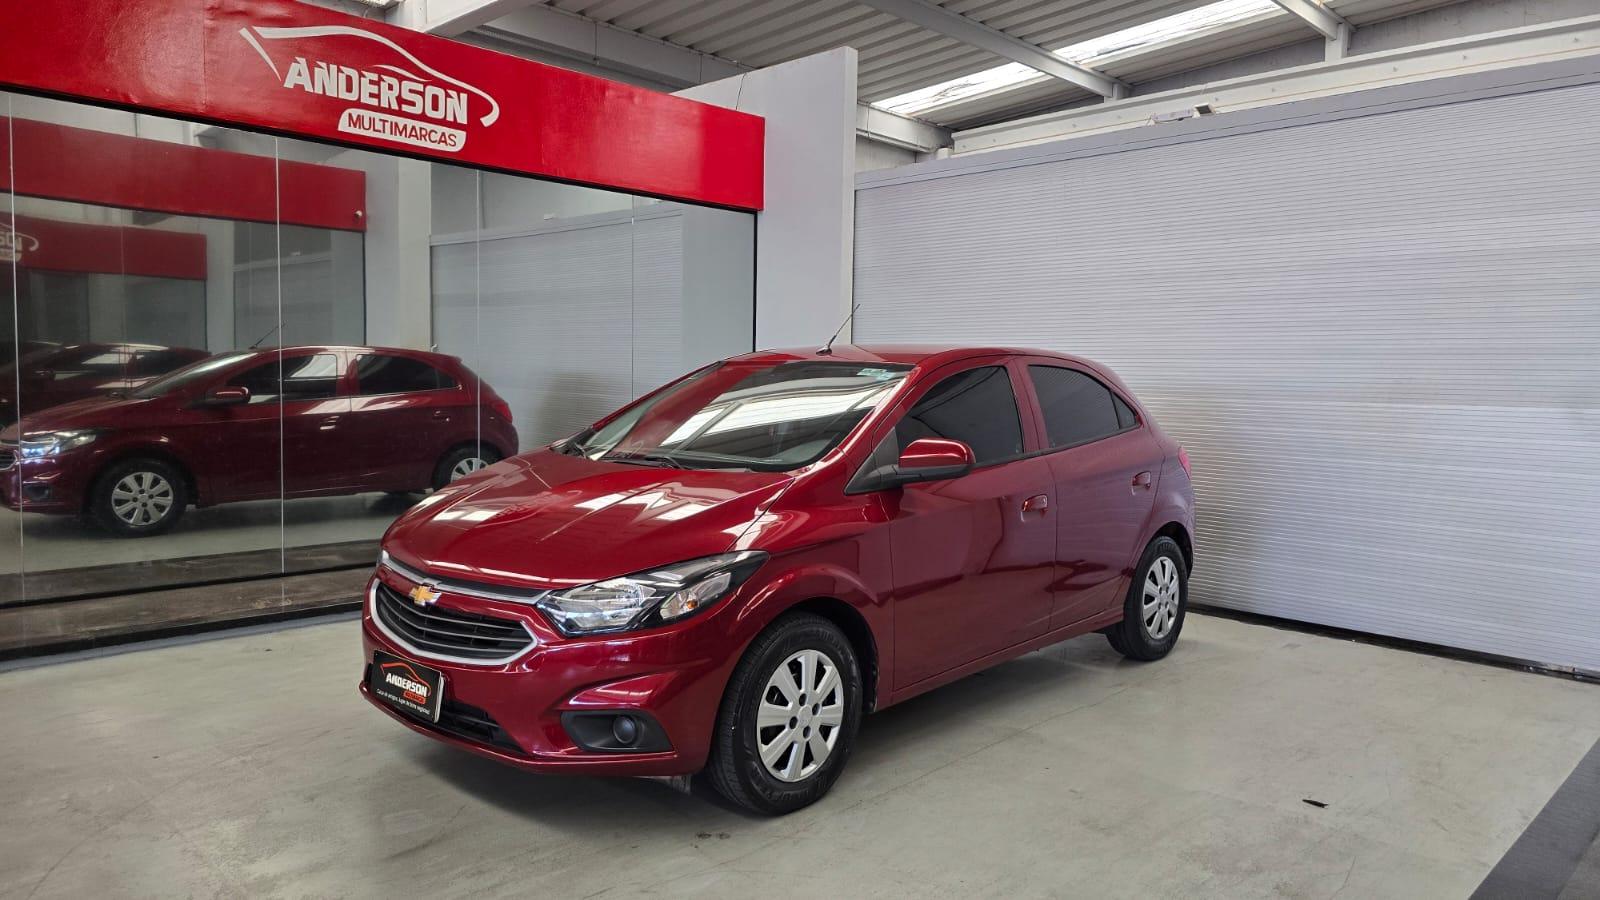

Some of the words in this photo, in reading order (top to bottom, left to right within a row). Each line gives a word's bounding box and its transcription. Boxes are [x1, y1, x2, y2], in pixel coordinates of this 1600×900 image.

[283, 56, 468, 125] ANDERSON
[347, 112, 457, 147] MULTIMARCAS
[385, 672, 427, 697] ANDERSON
